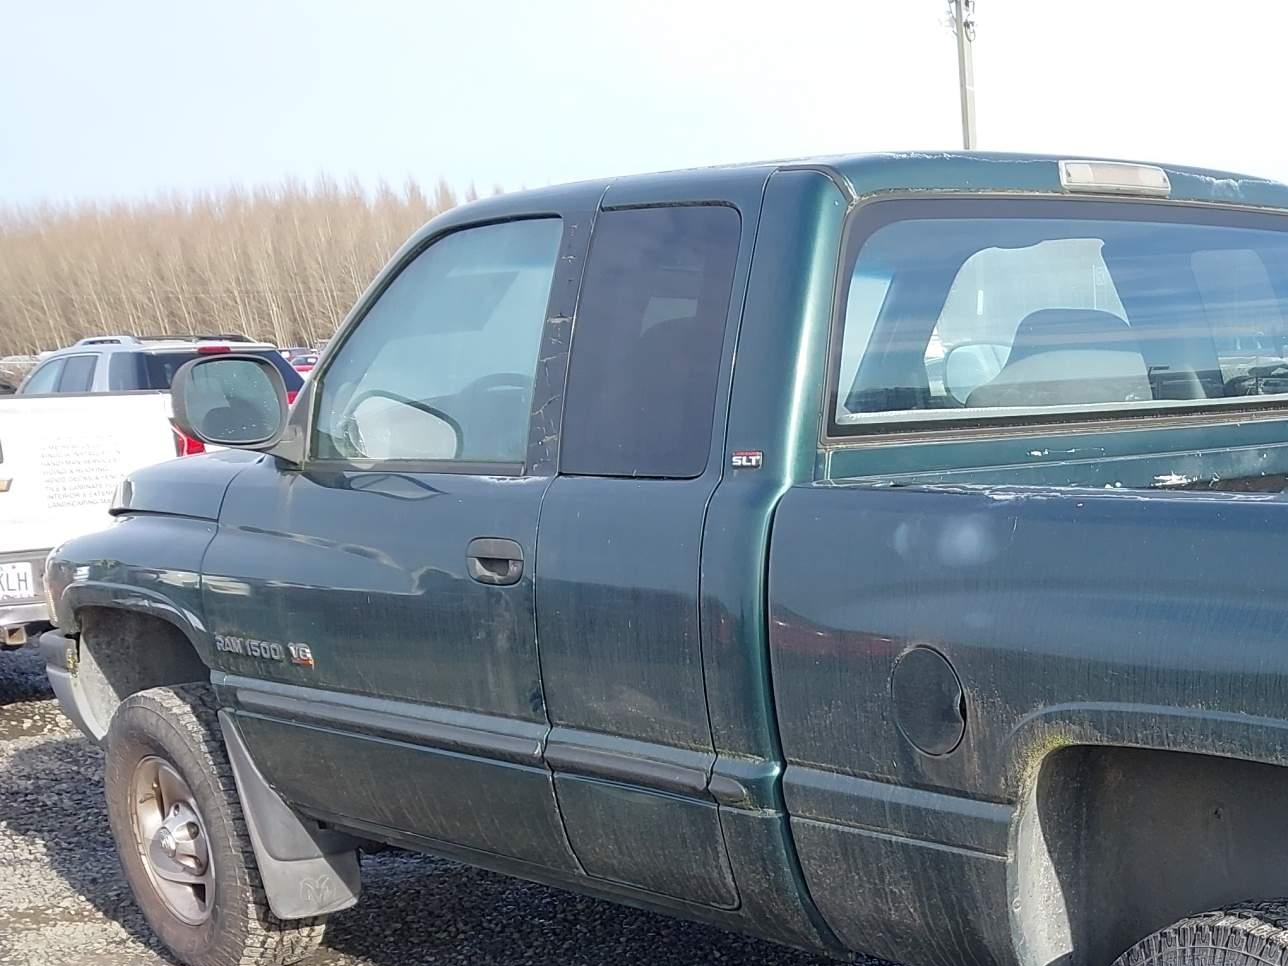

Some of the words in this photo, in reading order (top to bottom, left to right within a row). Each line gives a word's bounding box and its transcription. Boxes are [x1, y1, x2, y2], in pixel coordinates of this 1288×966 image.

[732, 455, 761, 466] SLT
[215, 634, 243, 654] RAM
[245, 639, 284, 661] 1500
